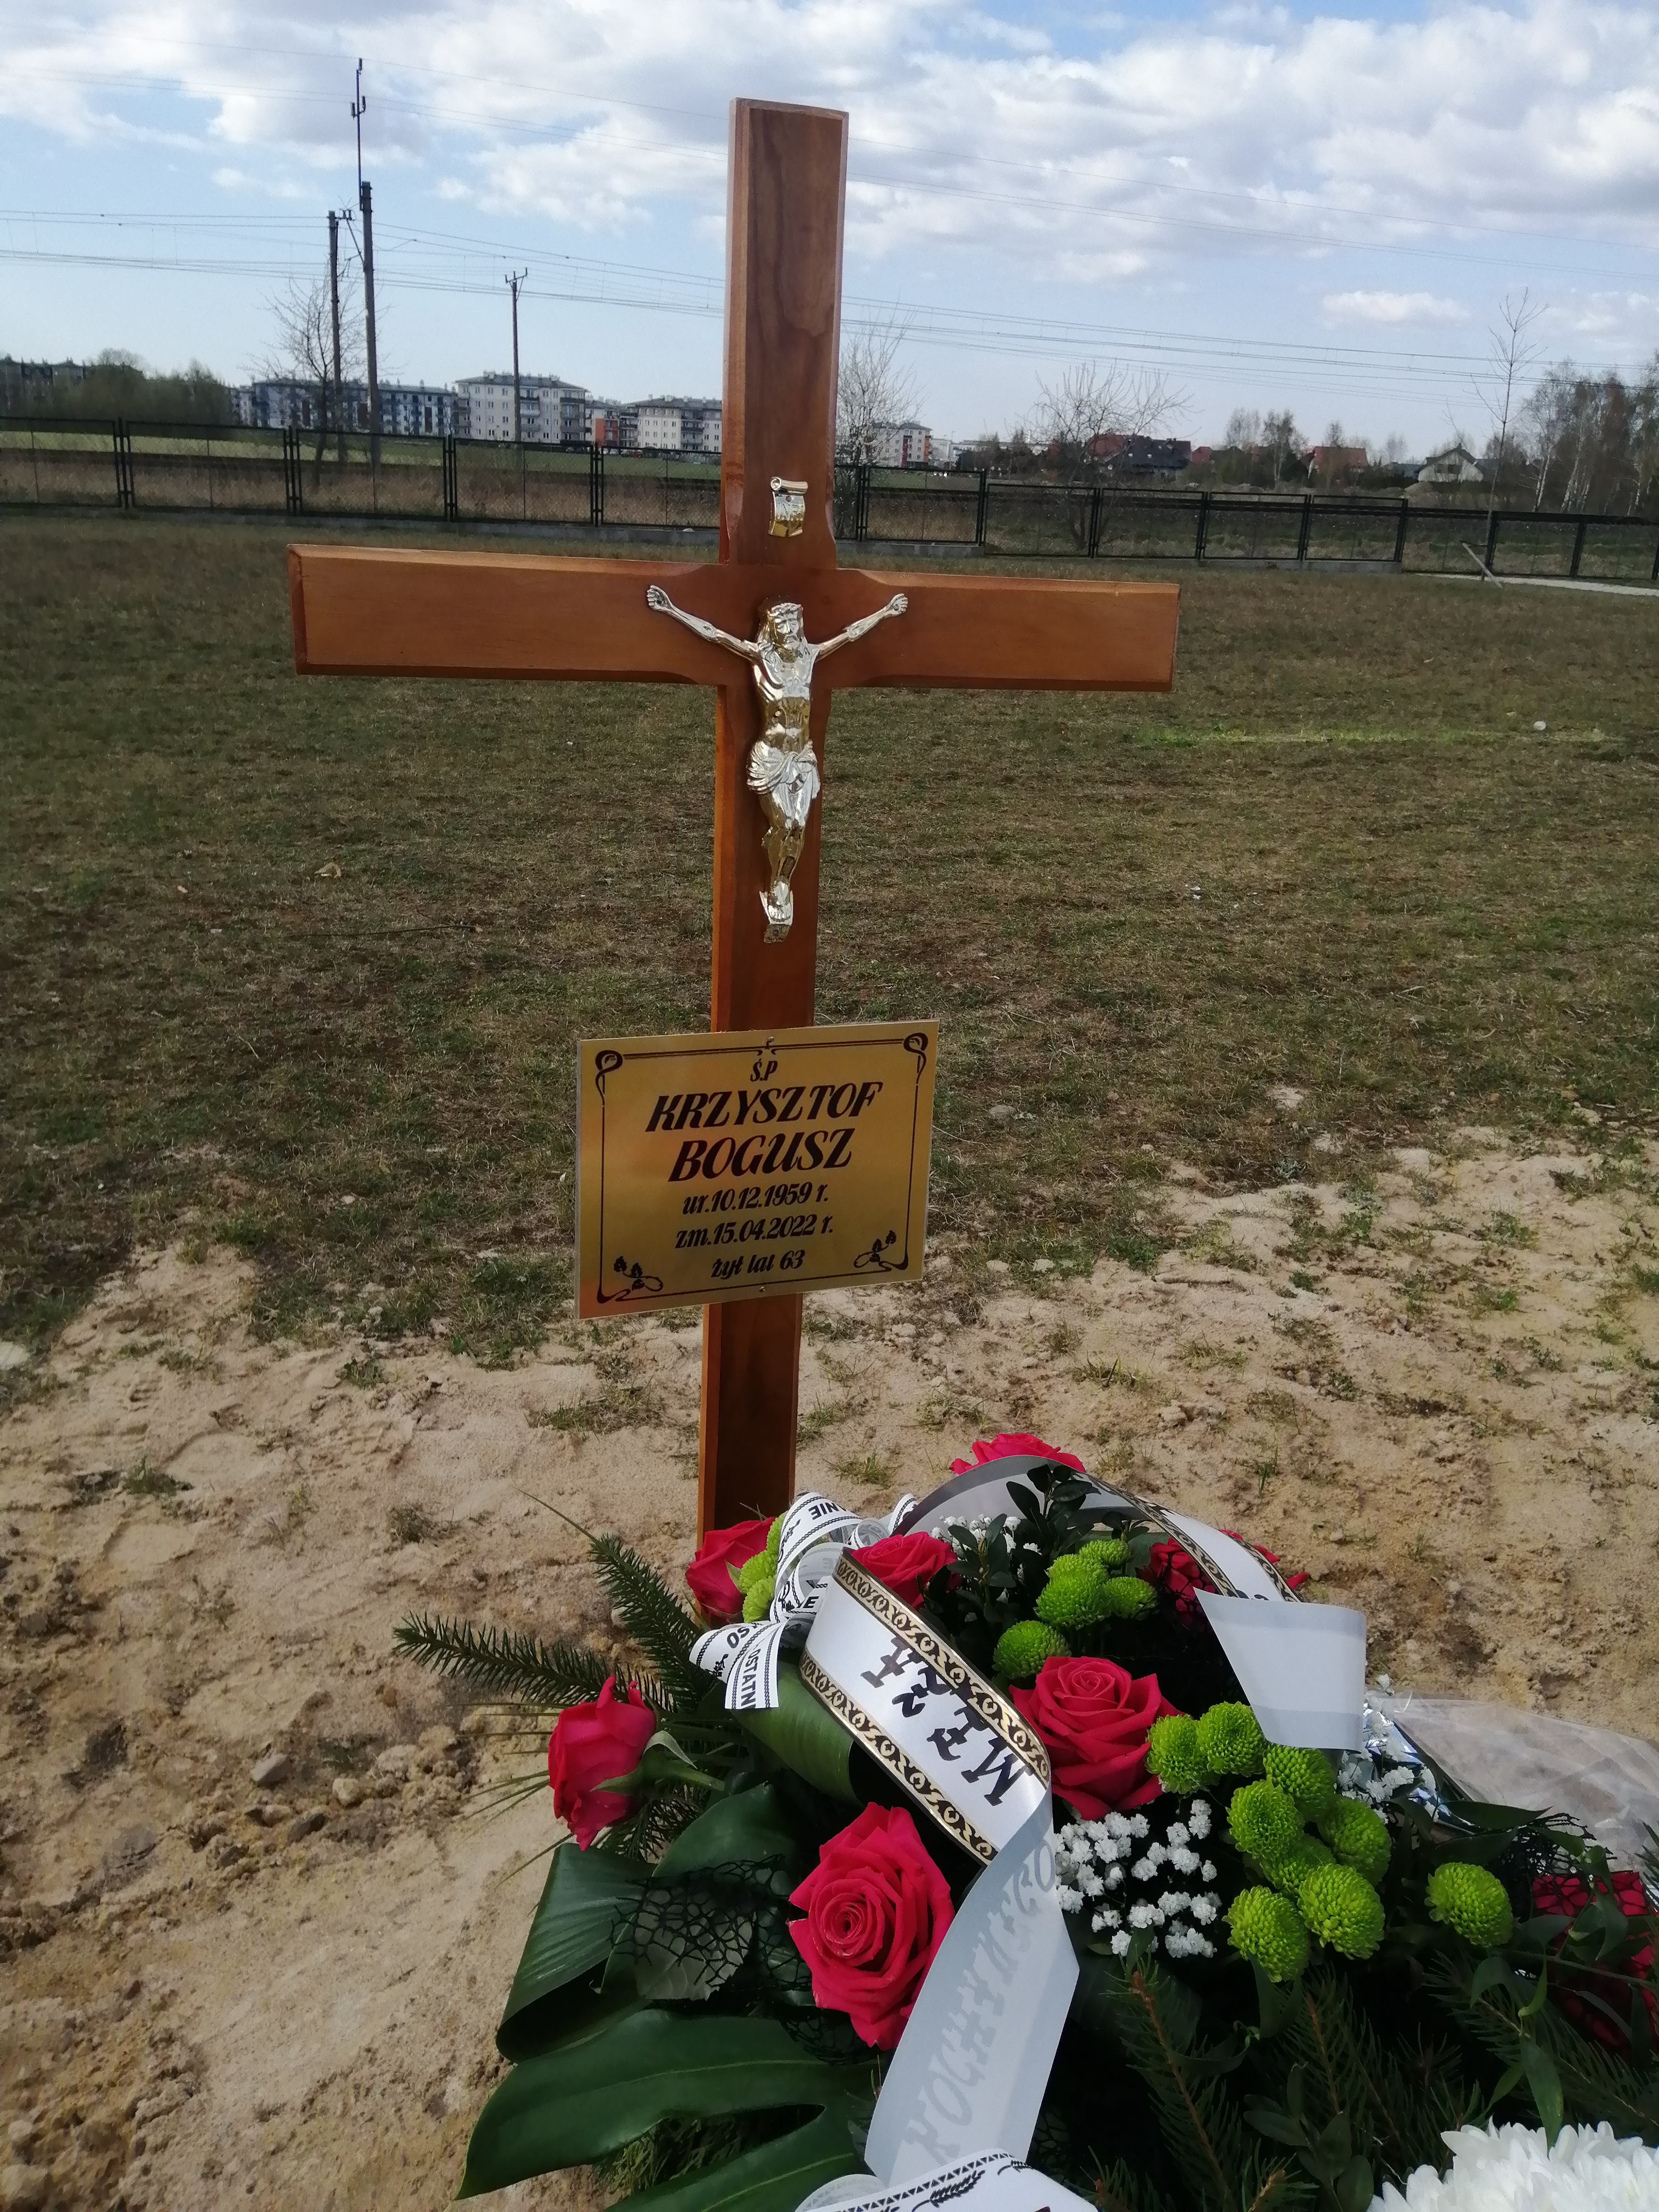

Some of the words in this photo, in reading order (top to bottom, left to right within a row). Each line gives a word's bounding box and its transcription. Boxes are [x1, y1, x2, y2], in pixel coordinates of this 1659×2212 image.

[645, 1082, 883, 1132] KRZYSZTOF
[667, 1128, 855, 1182] BOGUSZ
[682, 1182, 812, 1215] ur.10.12.1959
[815, 1184, 828, 1202] r.
[675, 1214, 817, 1249] zm.15.04.2022
[820, 1216, 833, 1234] r.
[747, 1254, 775, 1273] lat
[780, 1250, 805, 1270] 63
